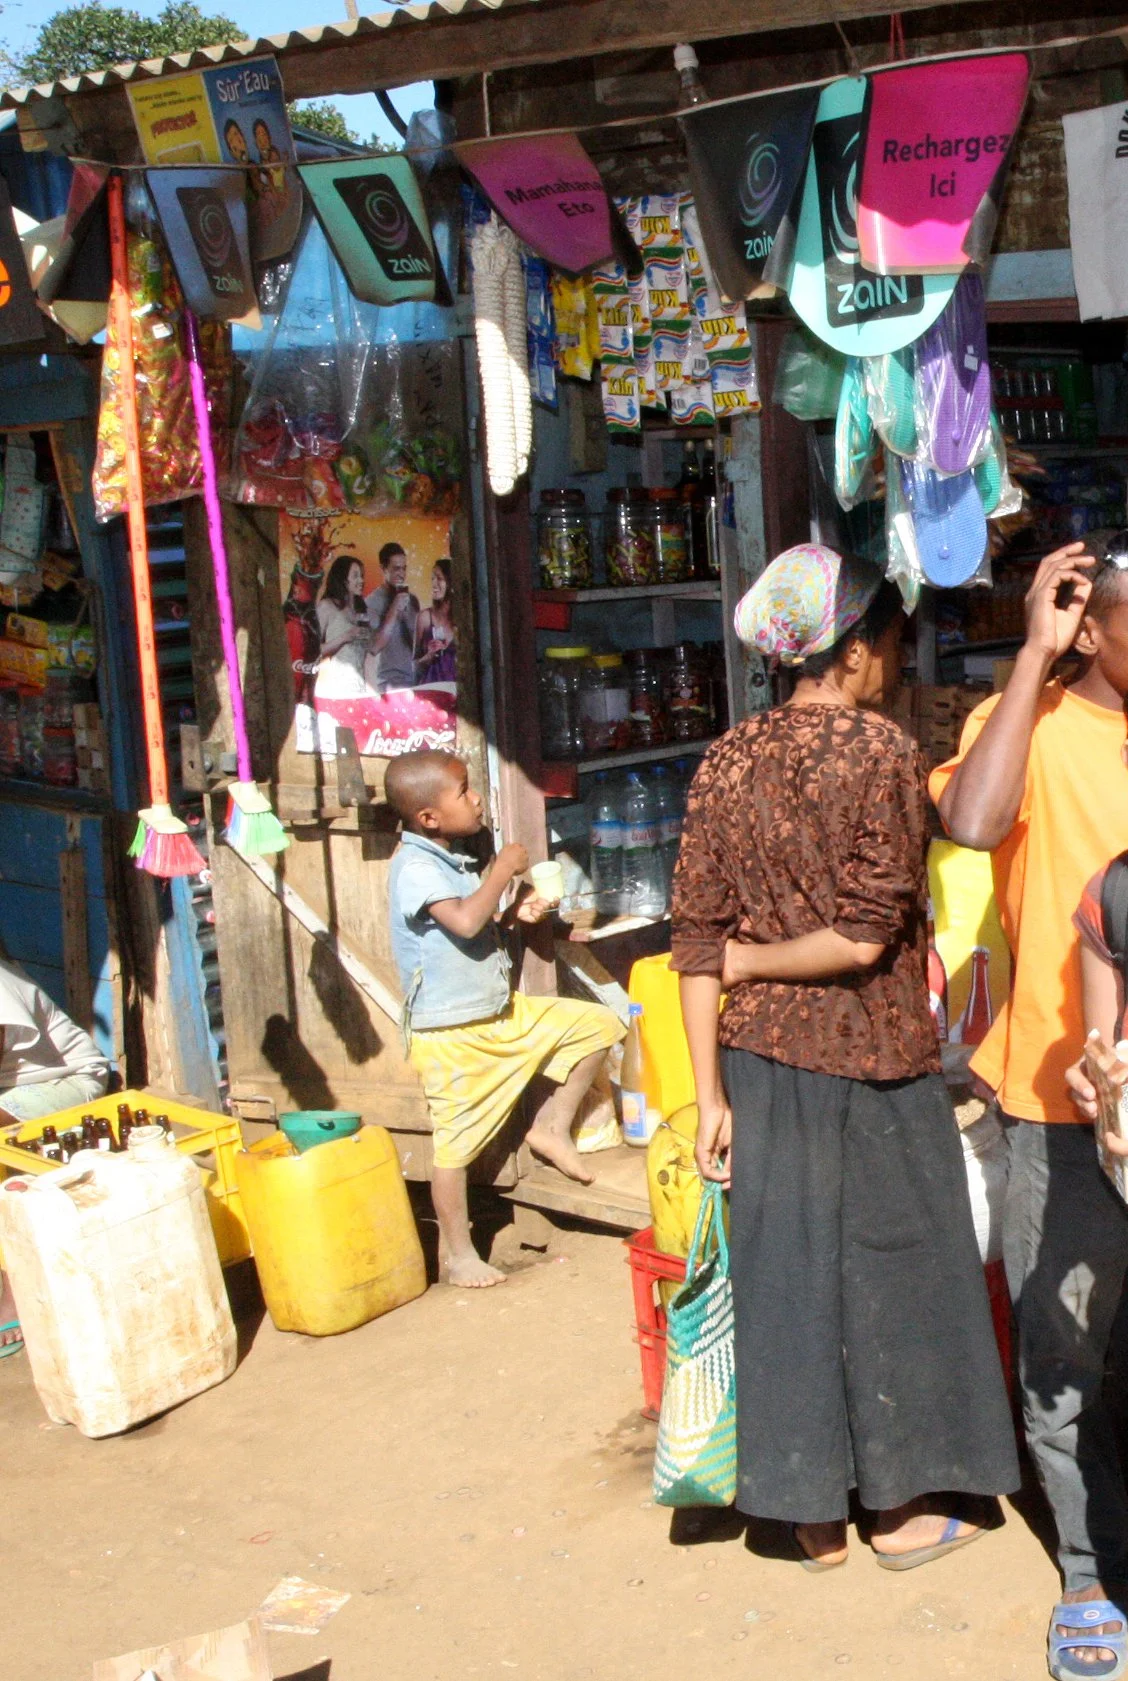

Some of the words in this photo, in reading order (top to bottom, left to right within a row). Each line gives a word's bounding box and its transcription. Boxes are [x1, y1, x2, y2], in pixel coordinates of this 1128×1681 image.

[883, 132, 1011, 163] Rechargez
[930, 170, 956, 198] Ici
[558, 202, 595, 217] Eto
